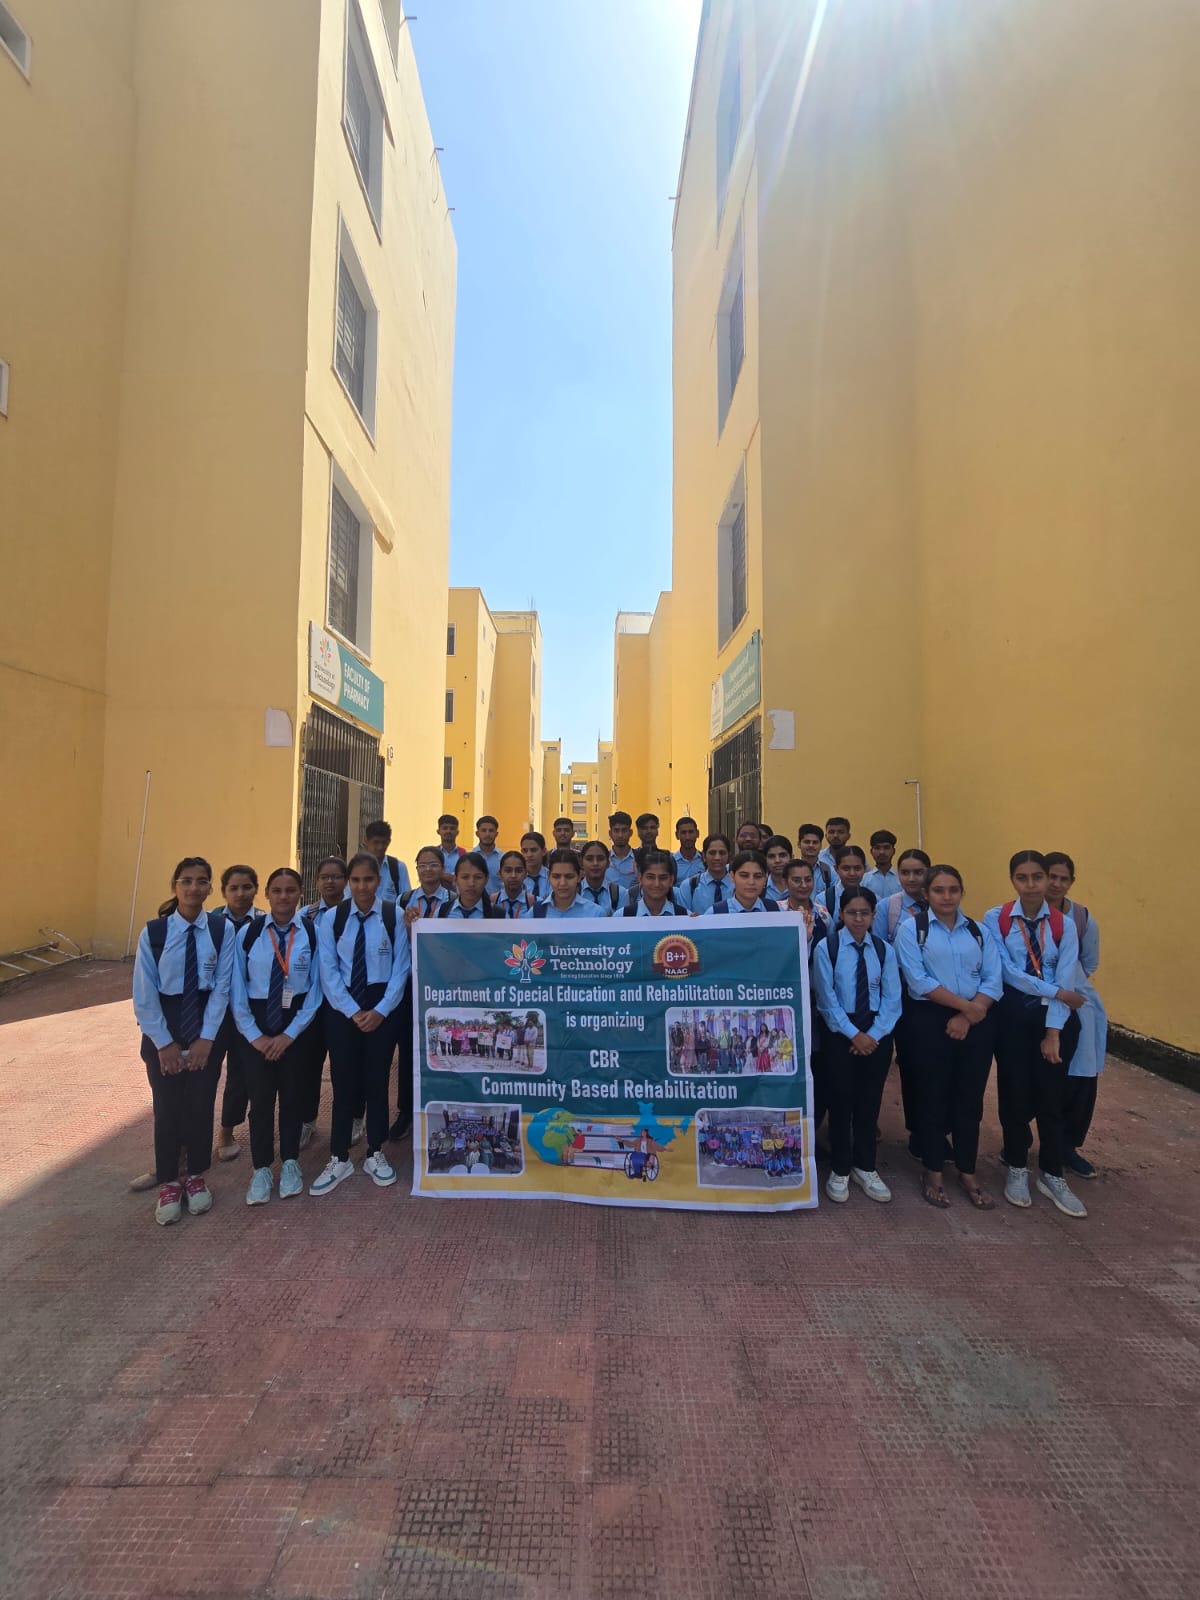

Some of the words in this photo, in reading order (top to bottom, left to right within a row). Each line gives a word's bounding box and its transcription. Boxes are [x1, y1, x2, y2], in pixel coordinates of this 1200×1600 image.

[344, 662, 364, 690] FACULTY
[364, 678, 371, 694] OF
[343, 681, 370, 712] PHARMACY
[550, 943, 615, 958] University
[618, 943, 631, 955] of
[666, 951, 687, 962] B++
[550, 958, 634, 973] Technology
[664, 967, 689, 975] NAAC
[424, 985, 490, 1005] Department
[494, 986, 506, 1002] of
[509, 985, 553, 1006] Special
[557, 985, 616, 1002] Education
[620, 985, 642, 1002] and
[646, 985, 734, 1001] Rehabilitation
[737, 983, 794, 1000] Sciences
[566, 1011, 577, 1028] is
[580, 1011, 646, 1031] organizing
[590, 1049, 620, 1068] CBR
[481, 1076, 567, 1101] Community
[571, 1079, 618, 1099] Based
[624, 1080, 738, 1100] Rehabilitation
